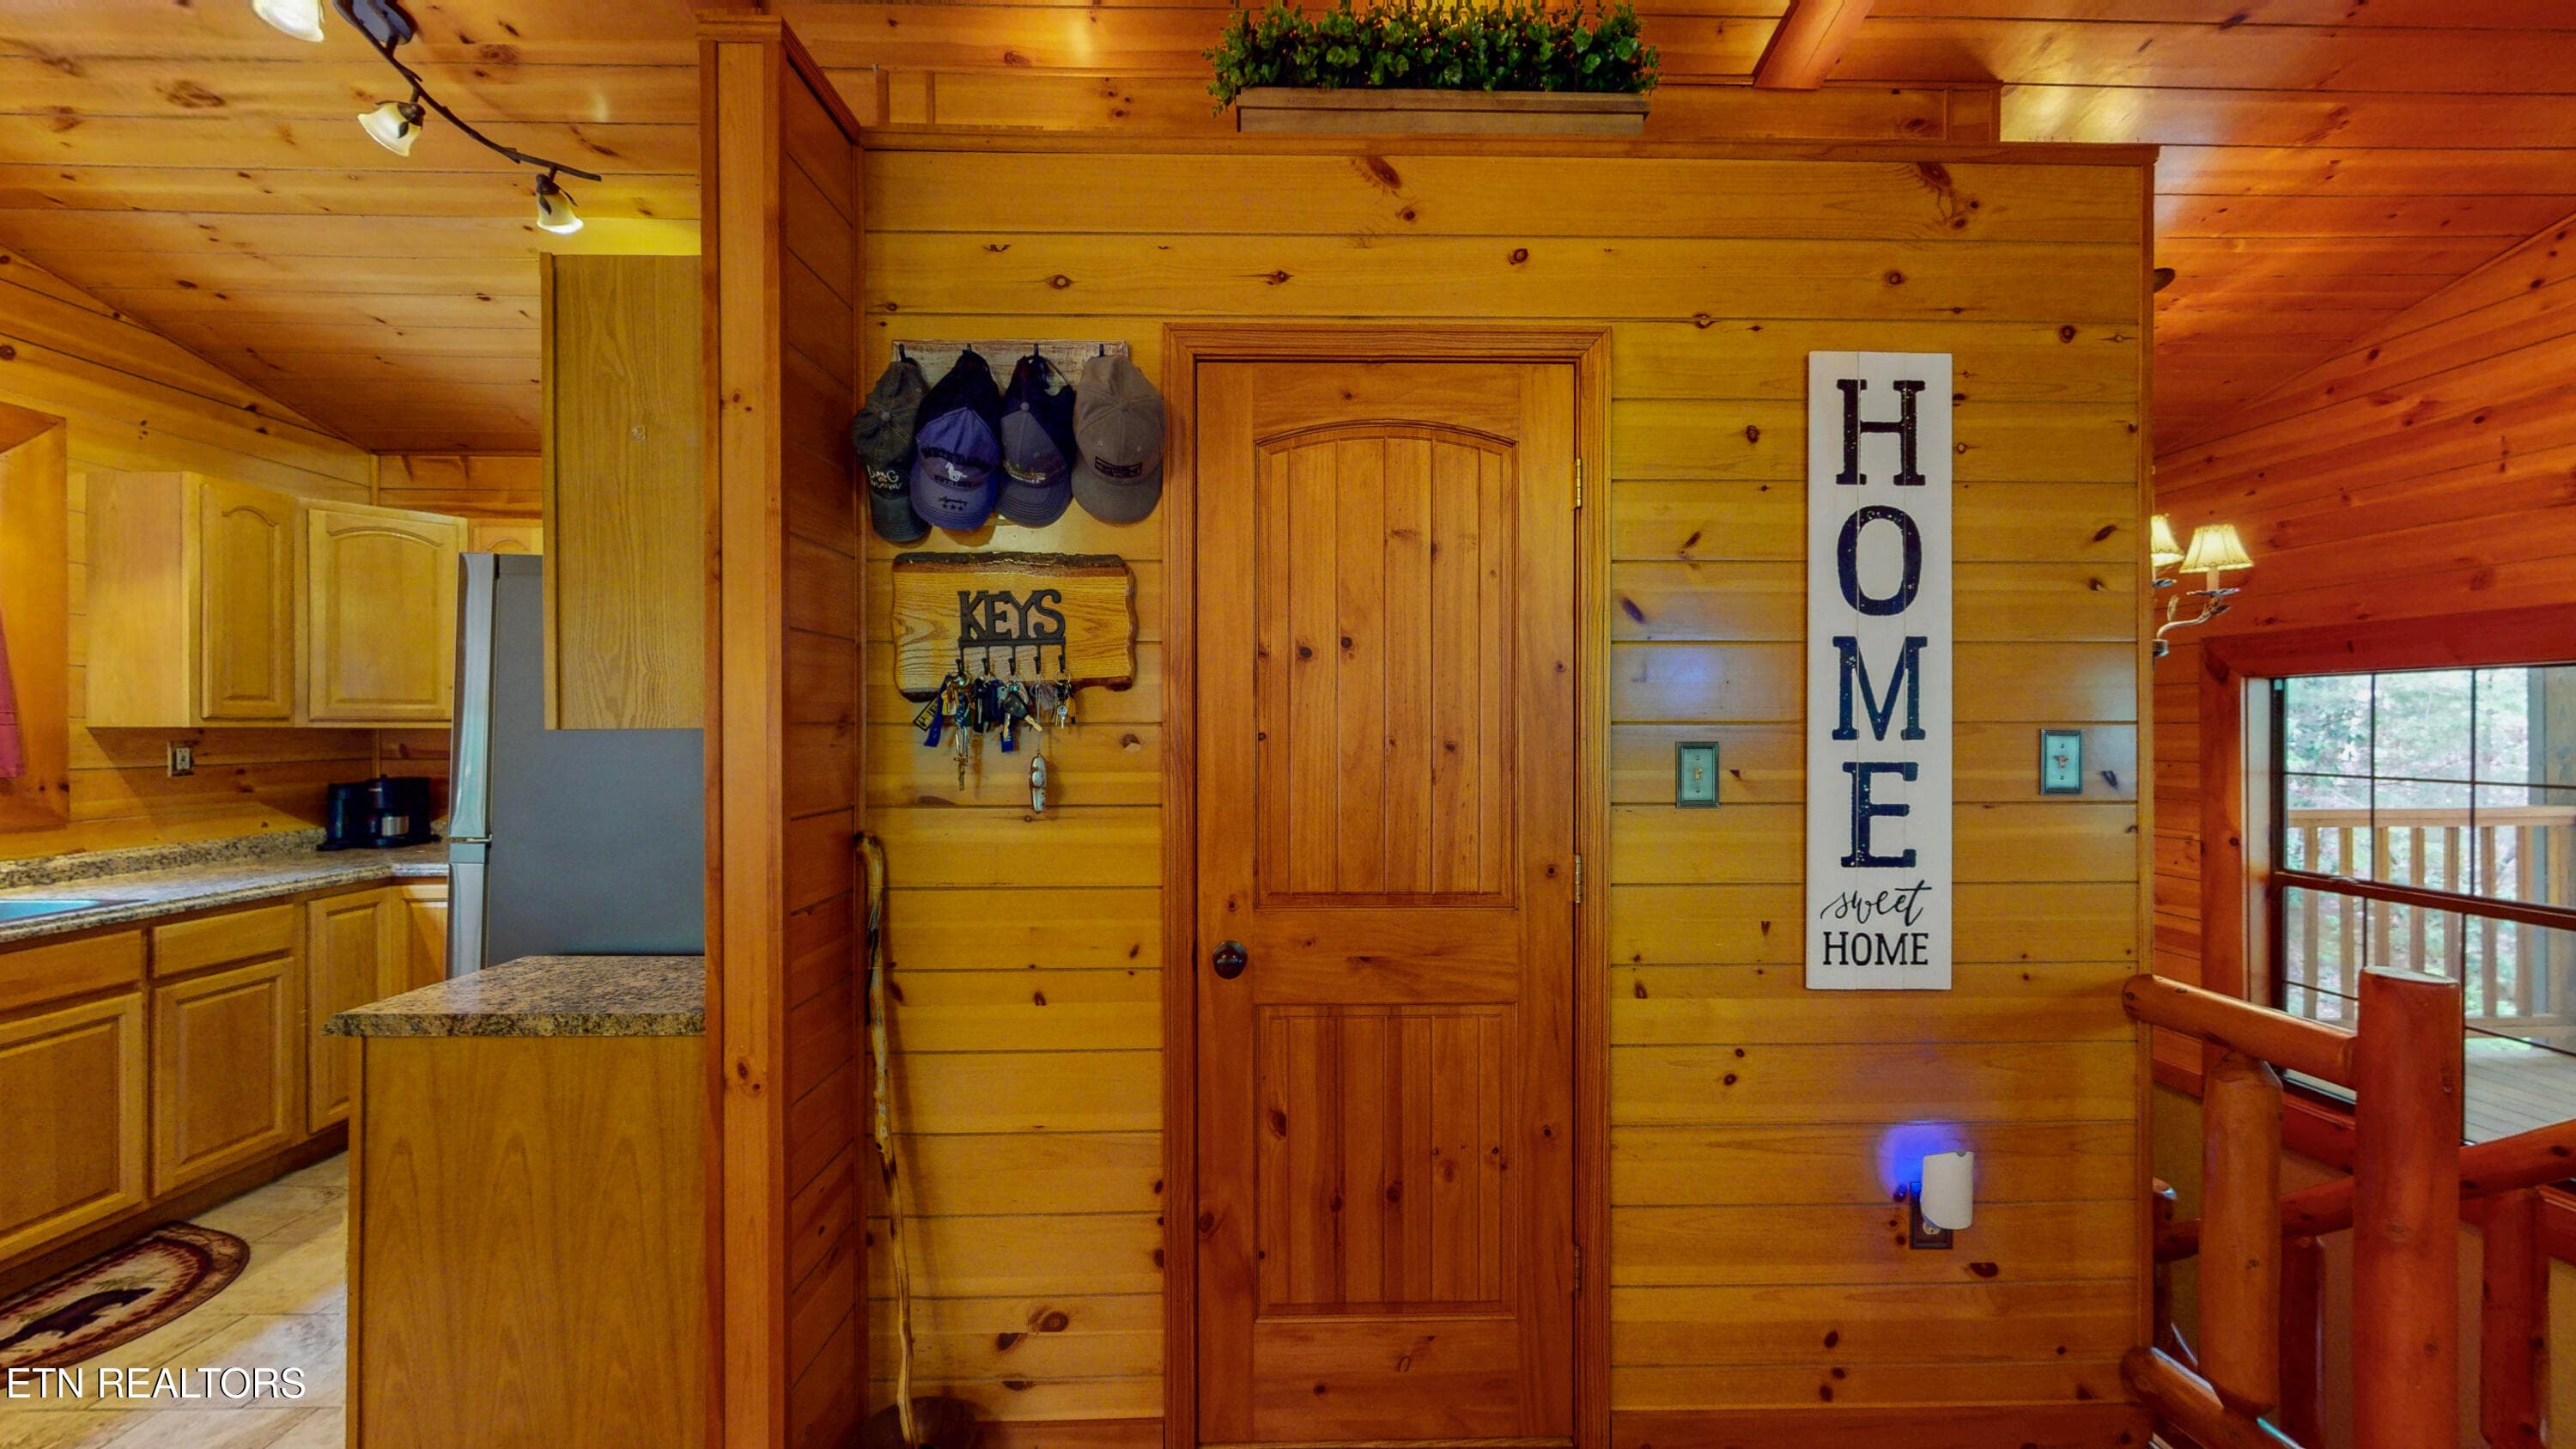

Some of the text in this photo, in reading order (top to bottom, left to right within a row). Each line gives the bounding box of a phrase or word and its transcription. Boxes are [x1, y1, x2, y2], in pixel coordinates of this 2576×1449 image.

[957, 588, 1066, 640] KEYS
[1832, 378, 1928, 868] HOME
[1820, 880, 1932, 926] sweet
[1823, 931, 1929, 966] HOME
